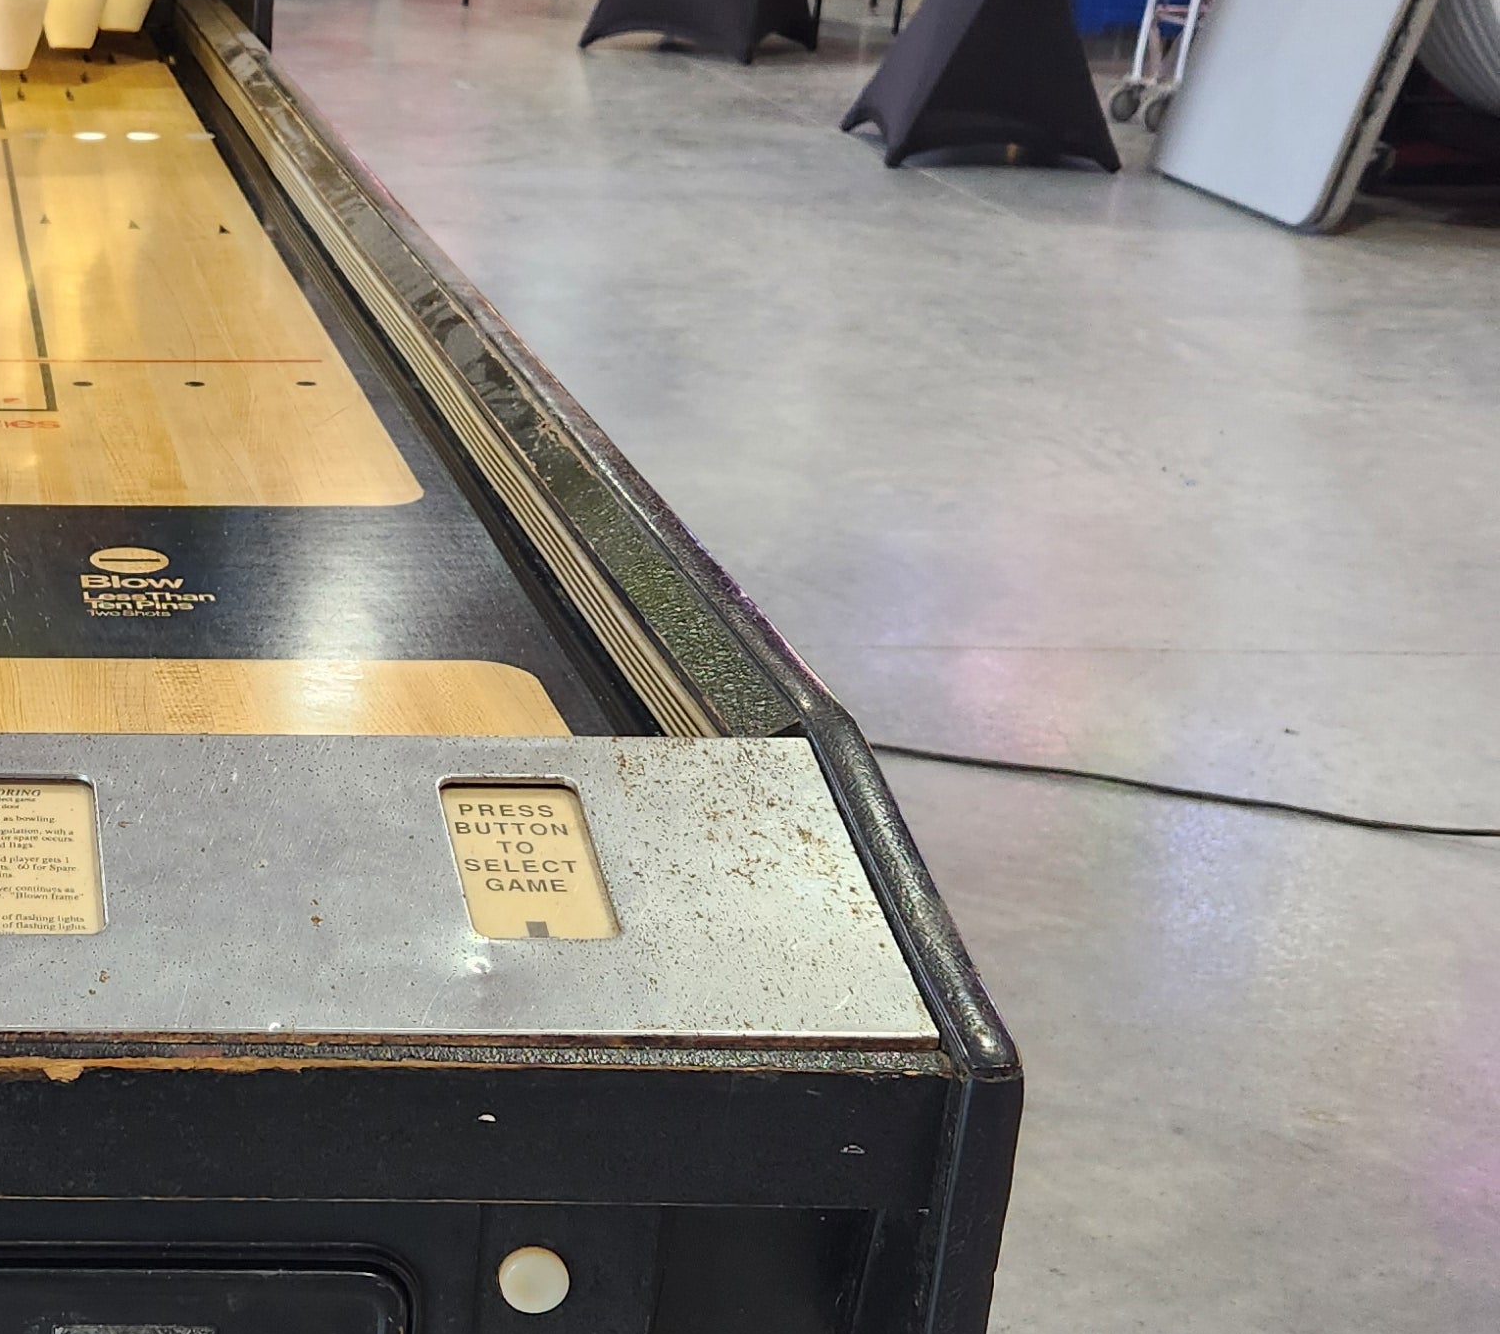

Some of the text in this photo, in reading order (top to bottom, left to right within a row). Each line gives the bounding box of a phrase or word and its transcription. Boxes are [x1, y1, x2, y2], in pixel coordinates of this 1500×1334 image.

[79, 574, 184, 589] Blow
[82, 591, 216, 602] Less Than
[83, 599, 195, 611] Ten Pins
[86, 609, 121, 617] Two
[458, 803, 554, 817] PRESS
[454, 821, 569, 836] BUTTON
[496, 840, 534, 854] TO
[9, 856, 40, 864] player
[463, 859, 577, 873] SELECT
[485, 878, 568, 892] GAME
[15, 914, 54, 923] flashing
[58, 915, 85, 923] lights
